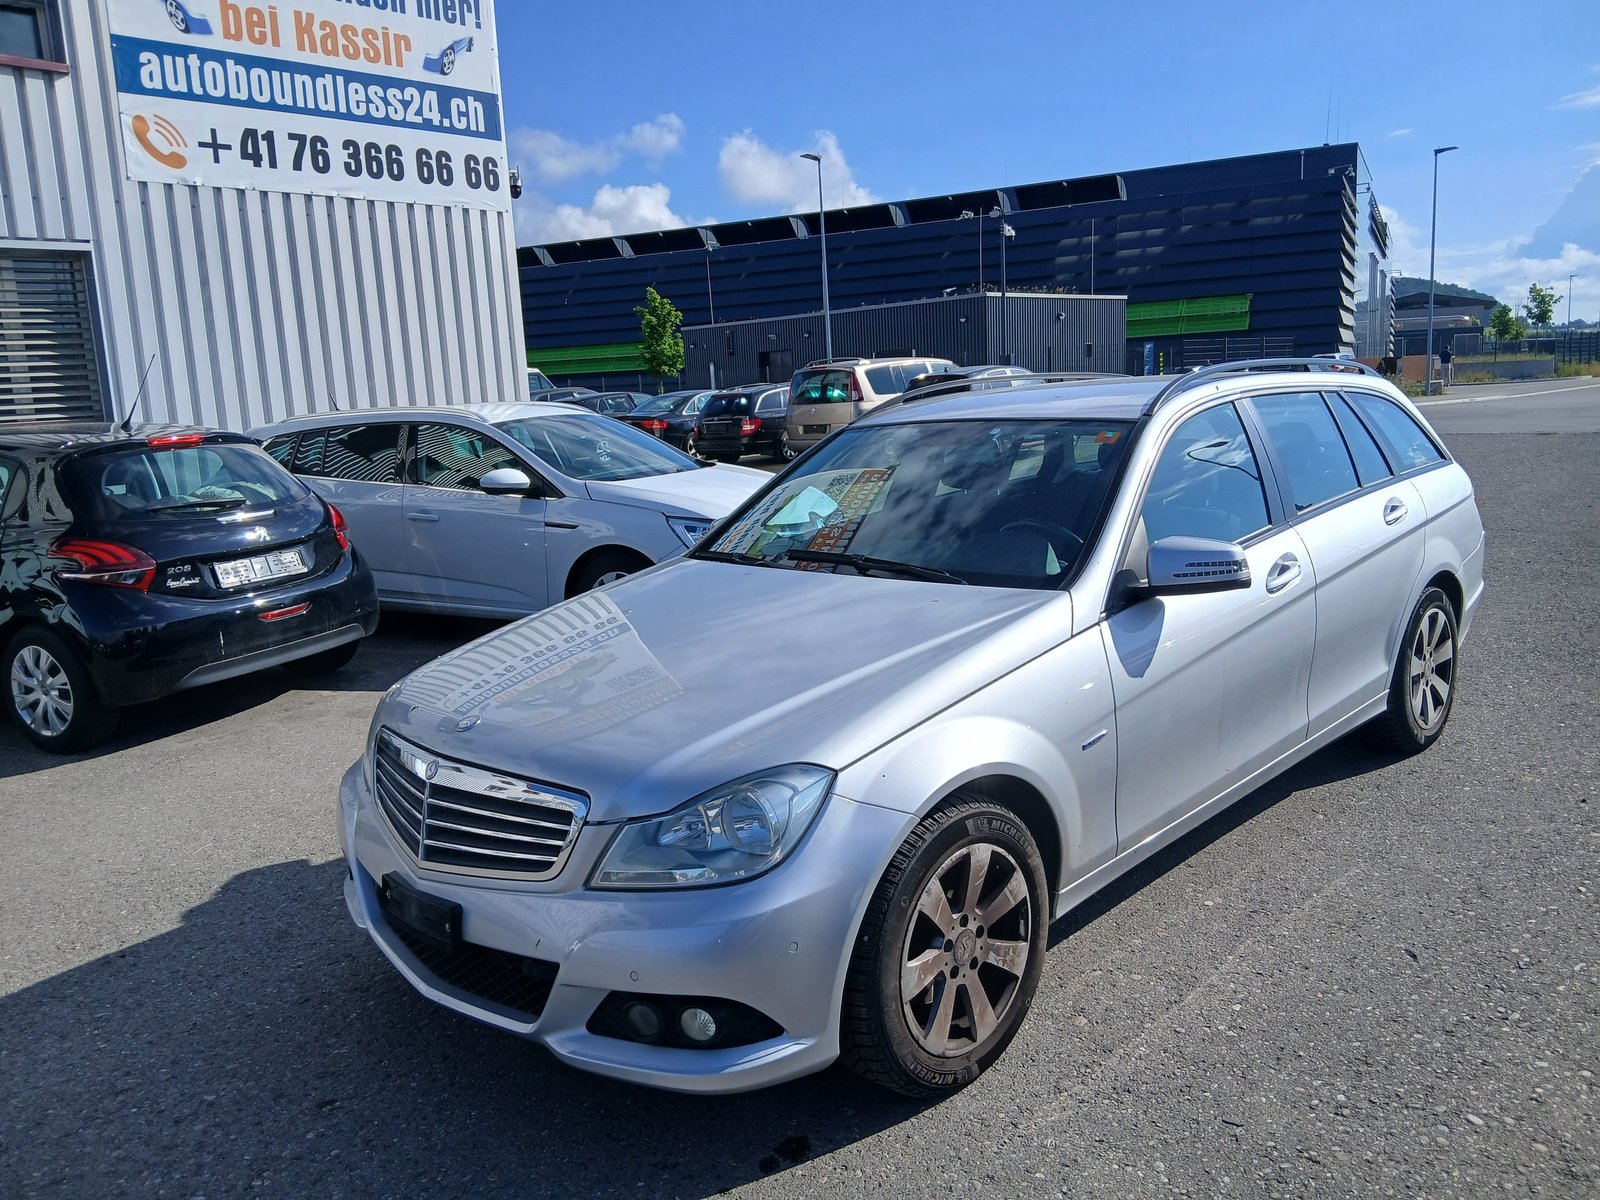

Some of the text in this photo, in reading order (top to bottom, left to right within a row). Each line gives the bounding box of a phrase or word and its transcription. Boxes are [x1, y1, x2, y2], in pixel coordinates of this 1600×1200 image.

[219, 0, 412, 68] bei Kassir
[139, 50, 486, 133] autoboundless24.ch
[287, 132, 331, 175] 76
[342, 138, 406, 182] 366
[415, 147, 454, 187] 66
[464, 153, 500, 192] 66
